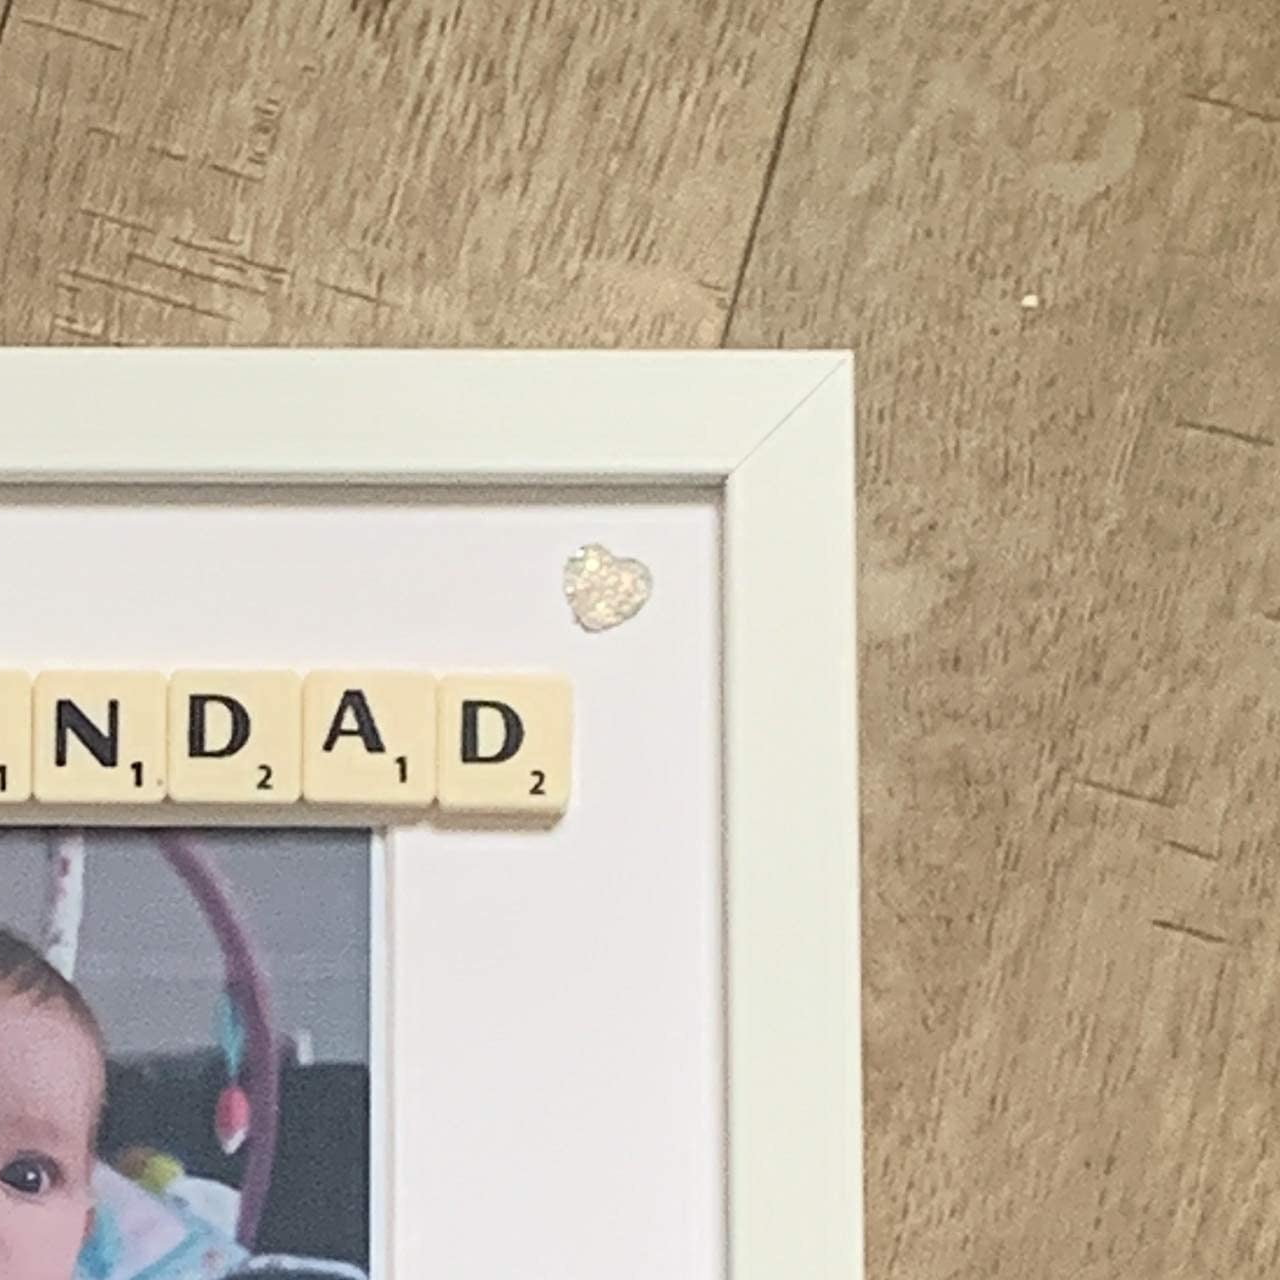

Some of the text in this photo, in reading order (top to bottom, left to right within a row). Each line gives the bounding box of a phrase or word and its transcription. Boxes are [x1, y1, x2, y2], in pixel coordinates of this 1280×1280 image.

[129, 761, 145, 788] 1
[256, 764, 274, 791] 2
[394, 756, 409, 784] 1
[528, 770, 548, 796] 2
